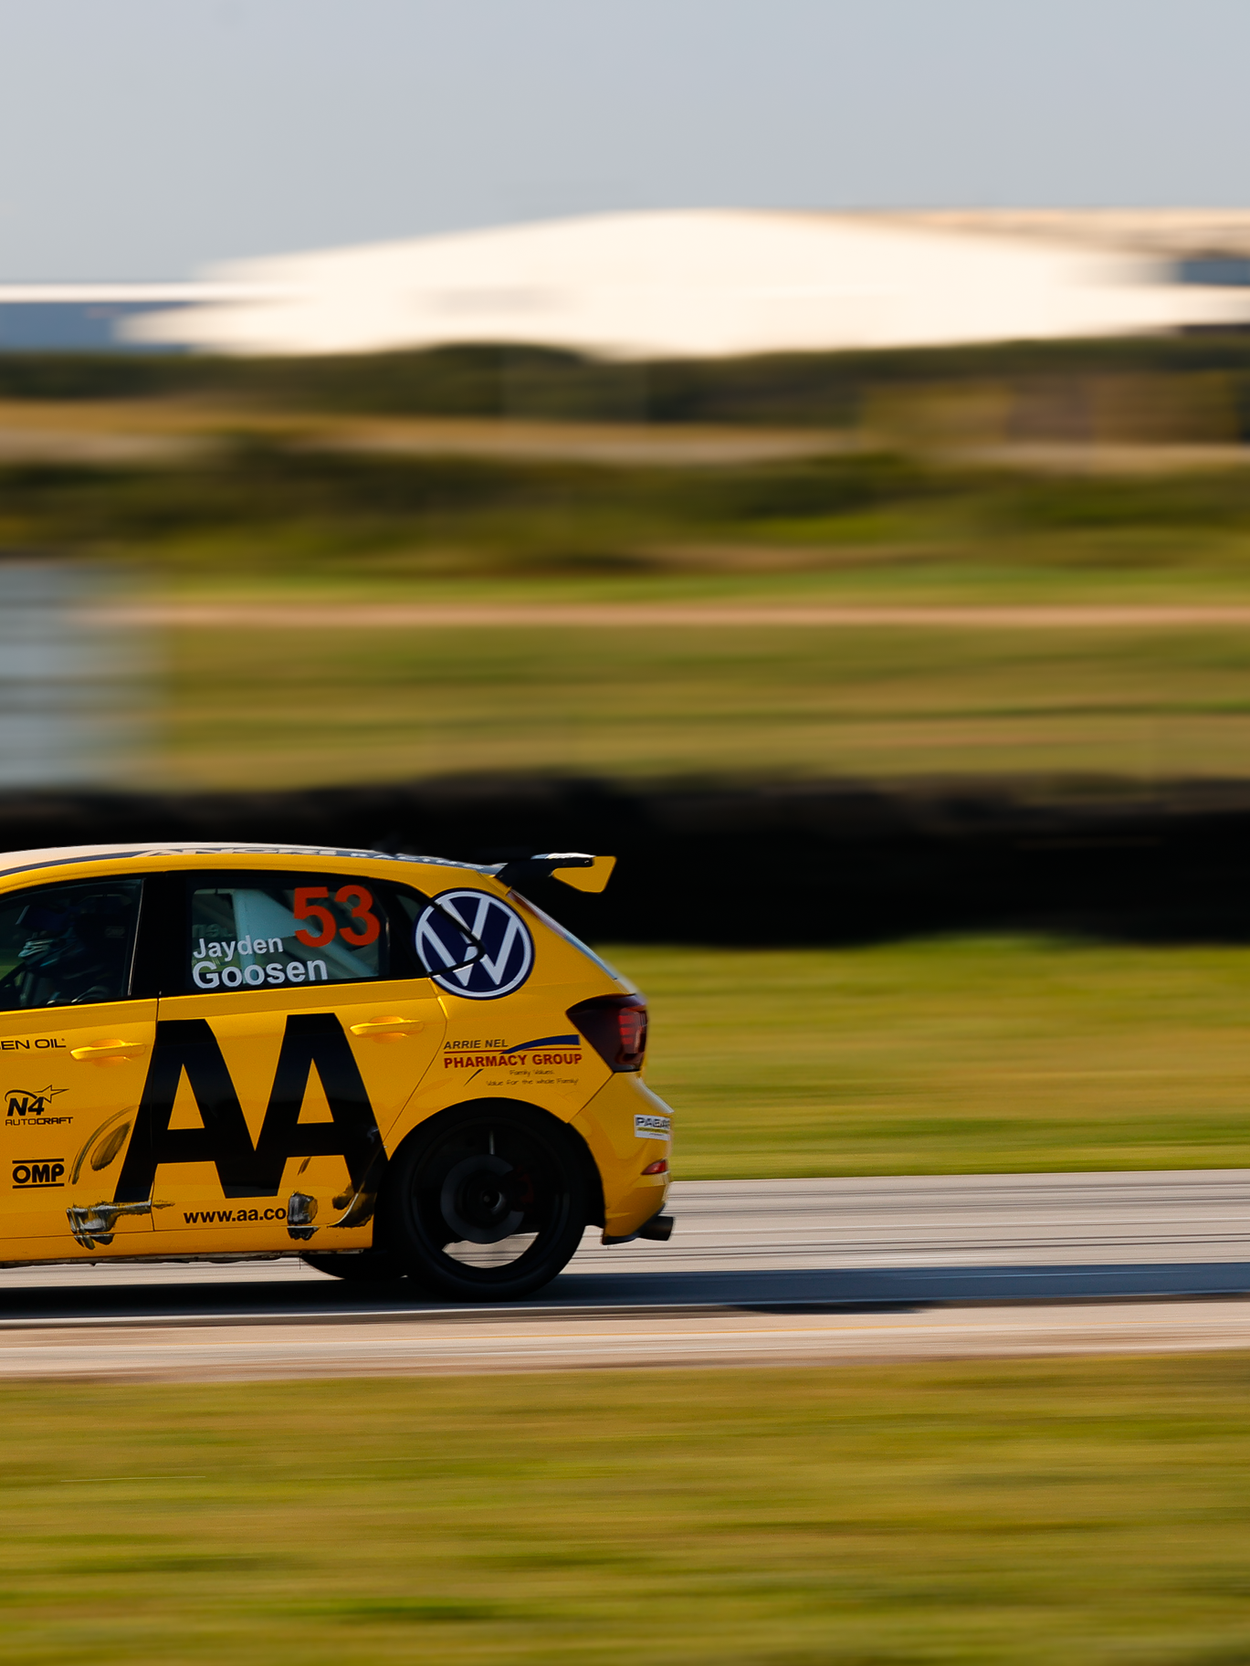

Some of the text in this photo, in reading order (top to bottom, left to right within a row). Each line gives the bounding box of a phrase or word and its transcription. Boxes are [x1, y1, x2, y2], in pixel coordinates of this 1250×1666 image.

[293, 885, 381, 948] 53
[193, 935, 284, 962] Jayden
[192, 959, 328, 990] Goosen
[35, 1038, 66, 1049] OIL
[444, 1039, 508, 1050] ARRIE NEL
[444, 1053, 582, 1069] PHARMACY GROUP
[7, 1097, 45, 1117] N4
[113, 1012, 389, 1201] AA
[5, 1117, 73, 1126] AUTOCRAFT
[12, 1163, 65, 1184] OMP
